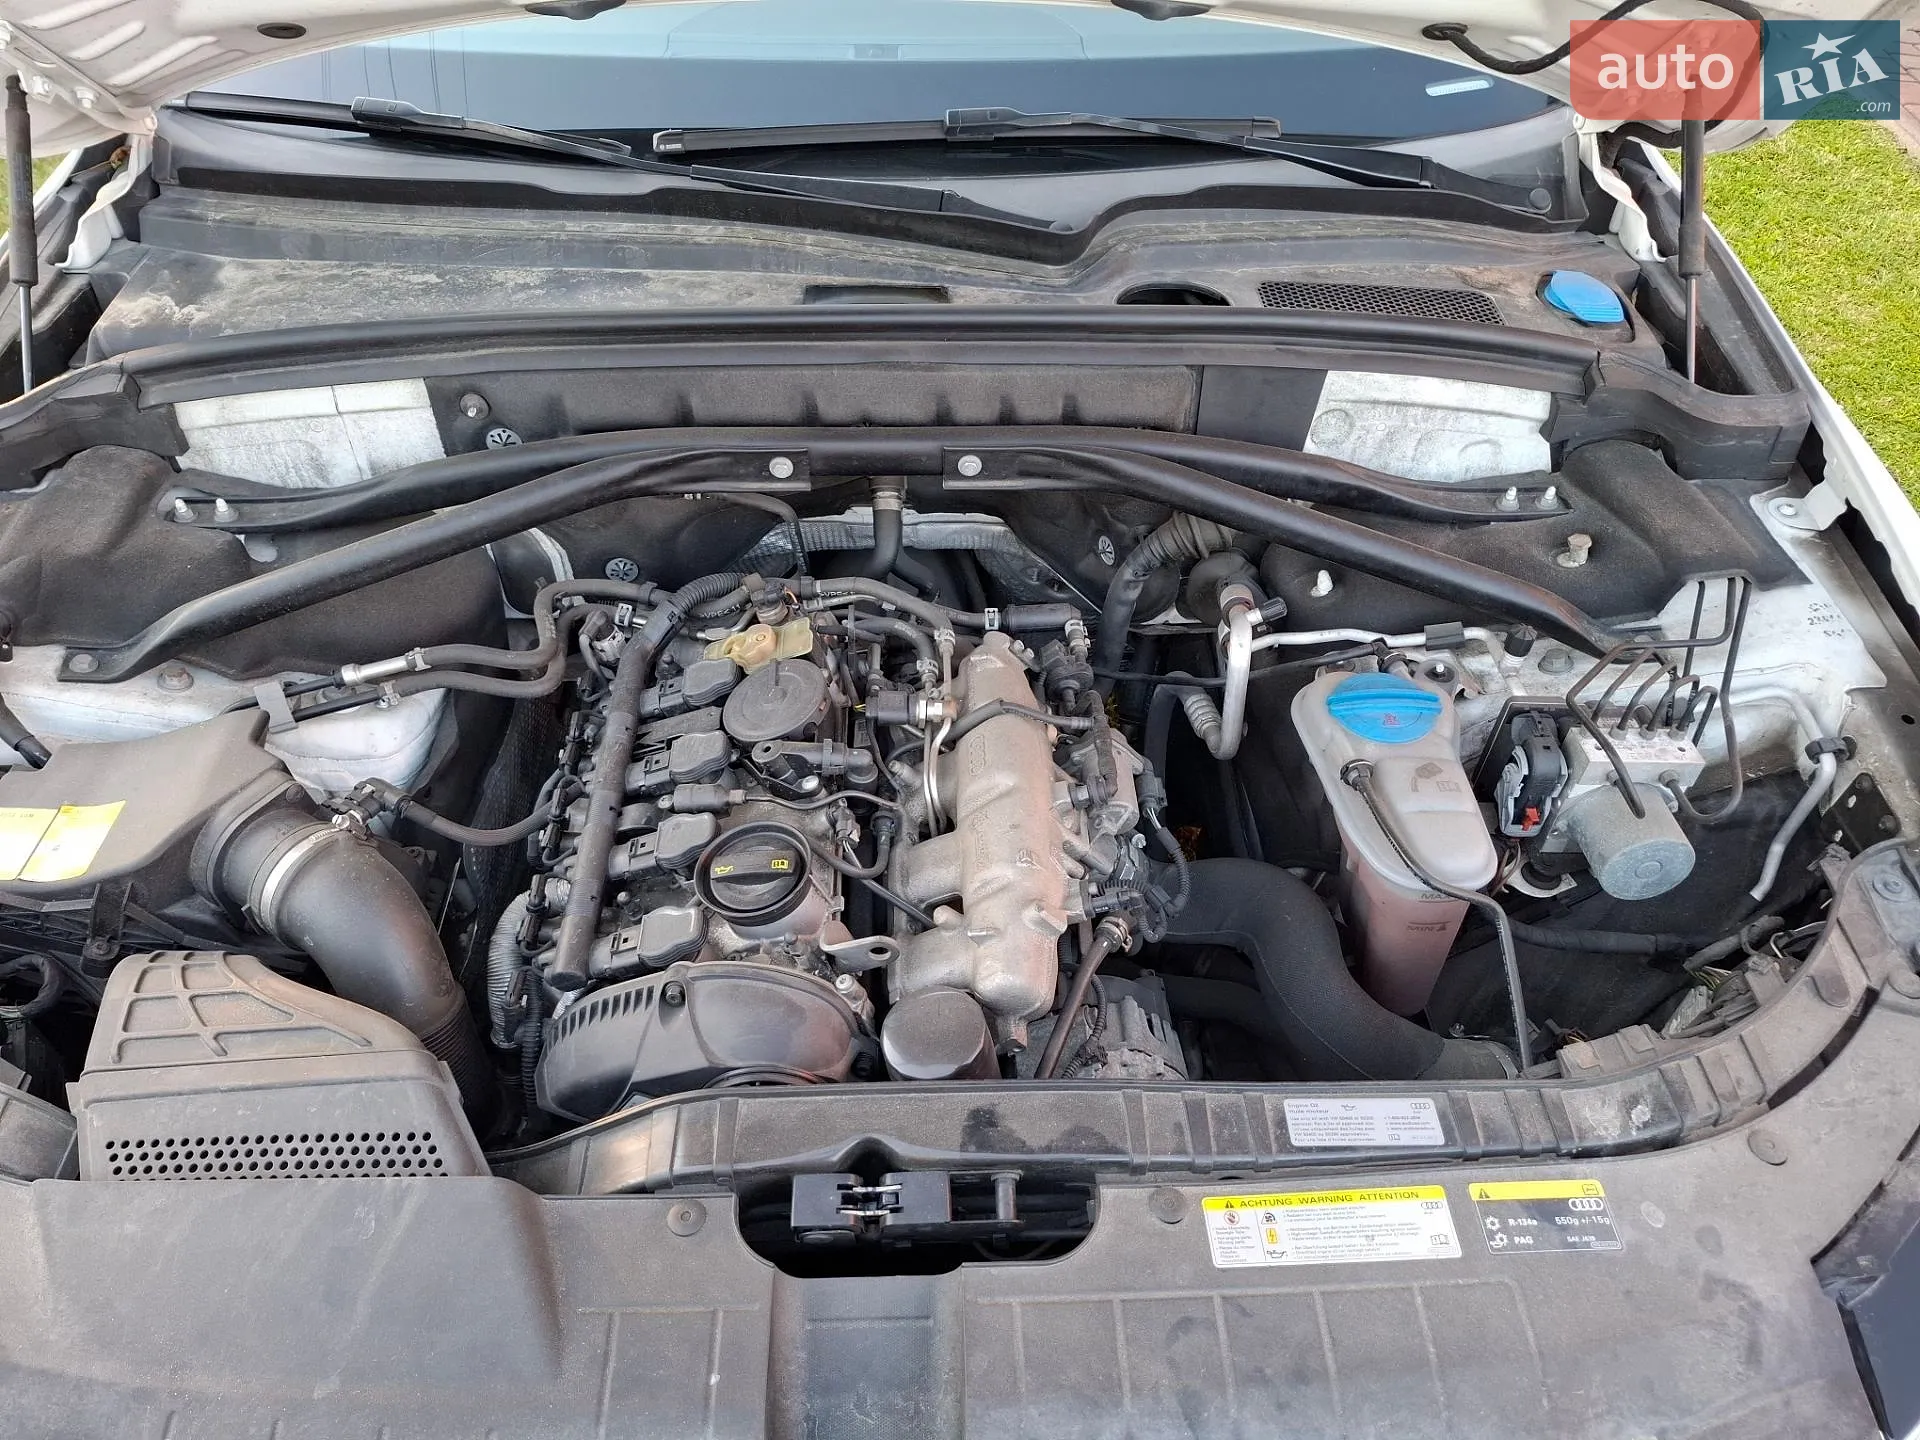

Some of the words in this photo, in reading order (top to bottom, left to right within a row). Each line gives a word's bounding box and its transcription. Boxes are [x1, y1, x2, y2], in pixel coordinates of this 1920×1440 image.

[1239, 1196, 1293, 1208] ACHTUNG
[1298, 1193, 1353, 1205] WARNING
[1359, 1190, 1419, 1201] ATTENTION
[1508, 1217, 1538, 1227] R-134a
[1554, 1216, 1579, 1226] 550g
[1513, 1235, 1534, 1245] PAG
